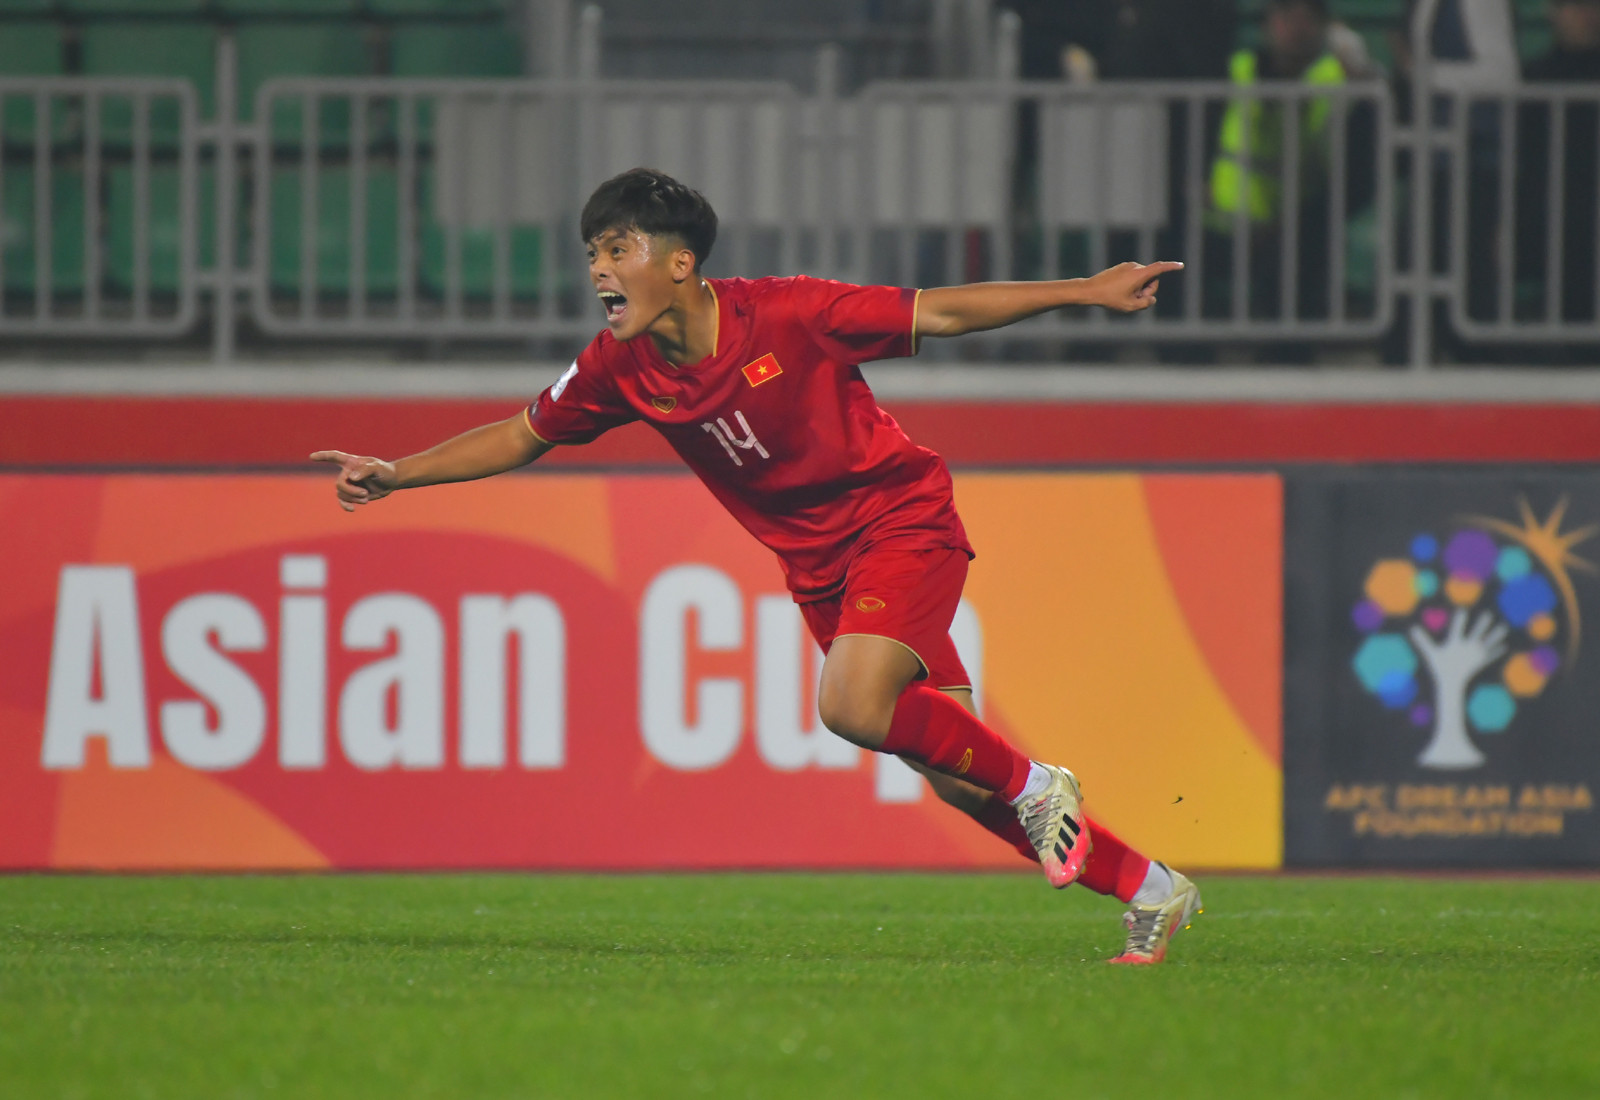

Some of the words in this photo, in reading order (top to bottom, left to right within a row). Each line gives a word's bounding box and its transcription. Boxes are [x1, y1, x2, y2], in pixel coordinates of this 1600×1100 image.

[700, 410, 770, 467] 14
[41, 555, 567, 770] Asian
[1325, 785, 1387, 809] AFC
[1396, 785, 1510, 809] DREAM
[1519, 785, 1591, 809] ASIA
[1354, 811, 1563, 836] FOUNDATION
